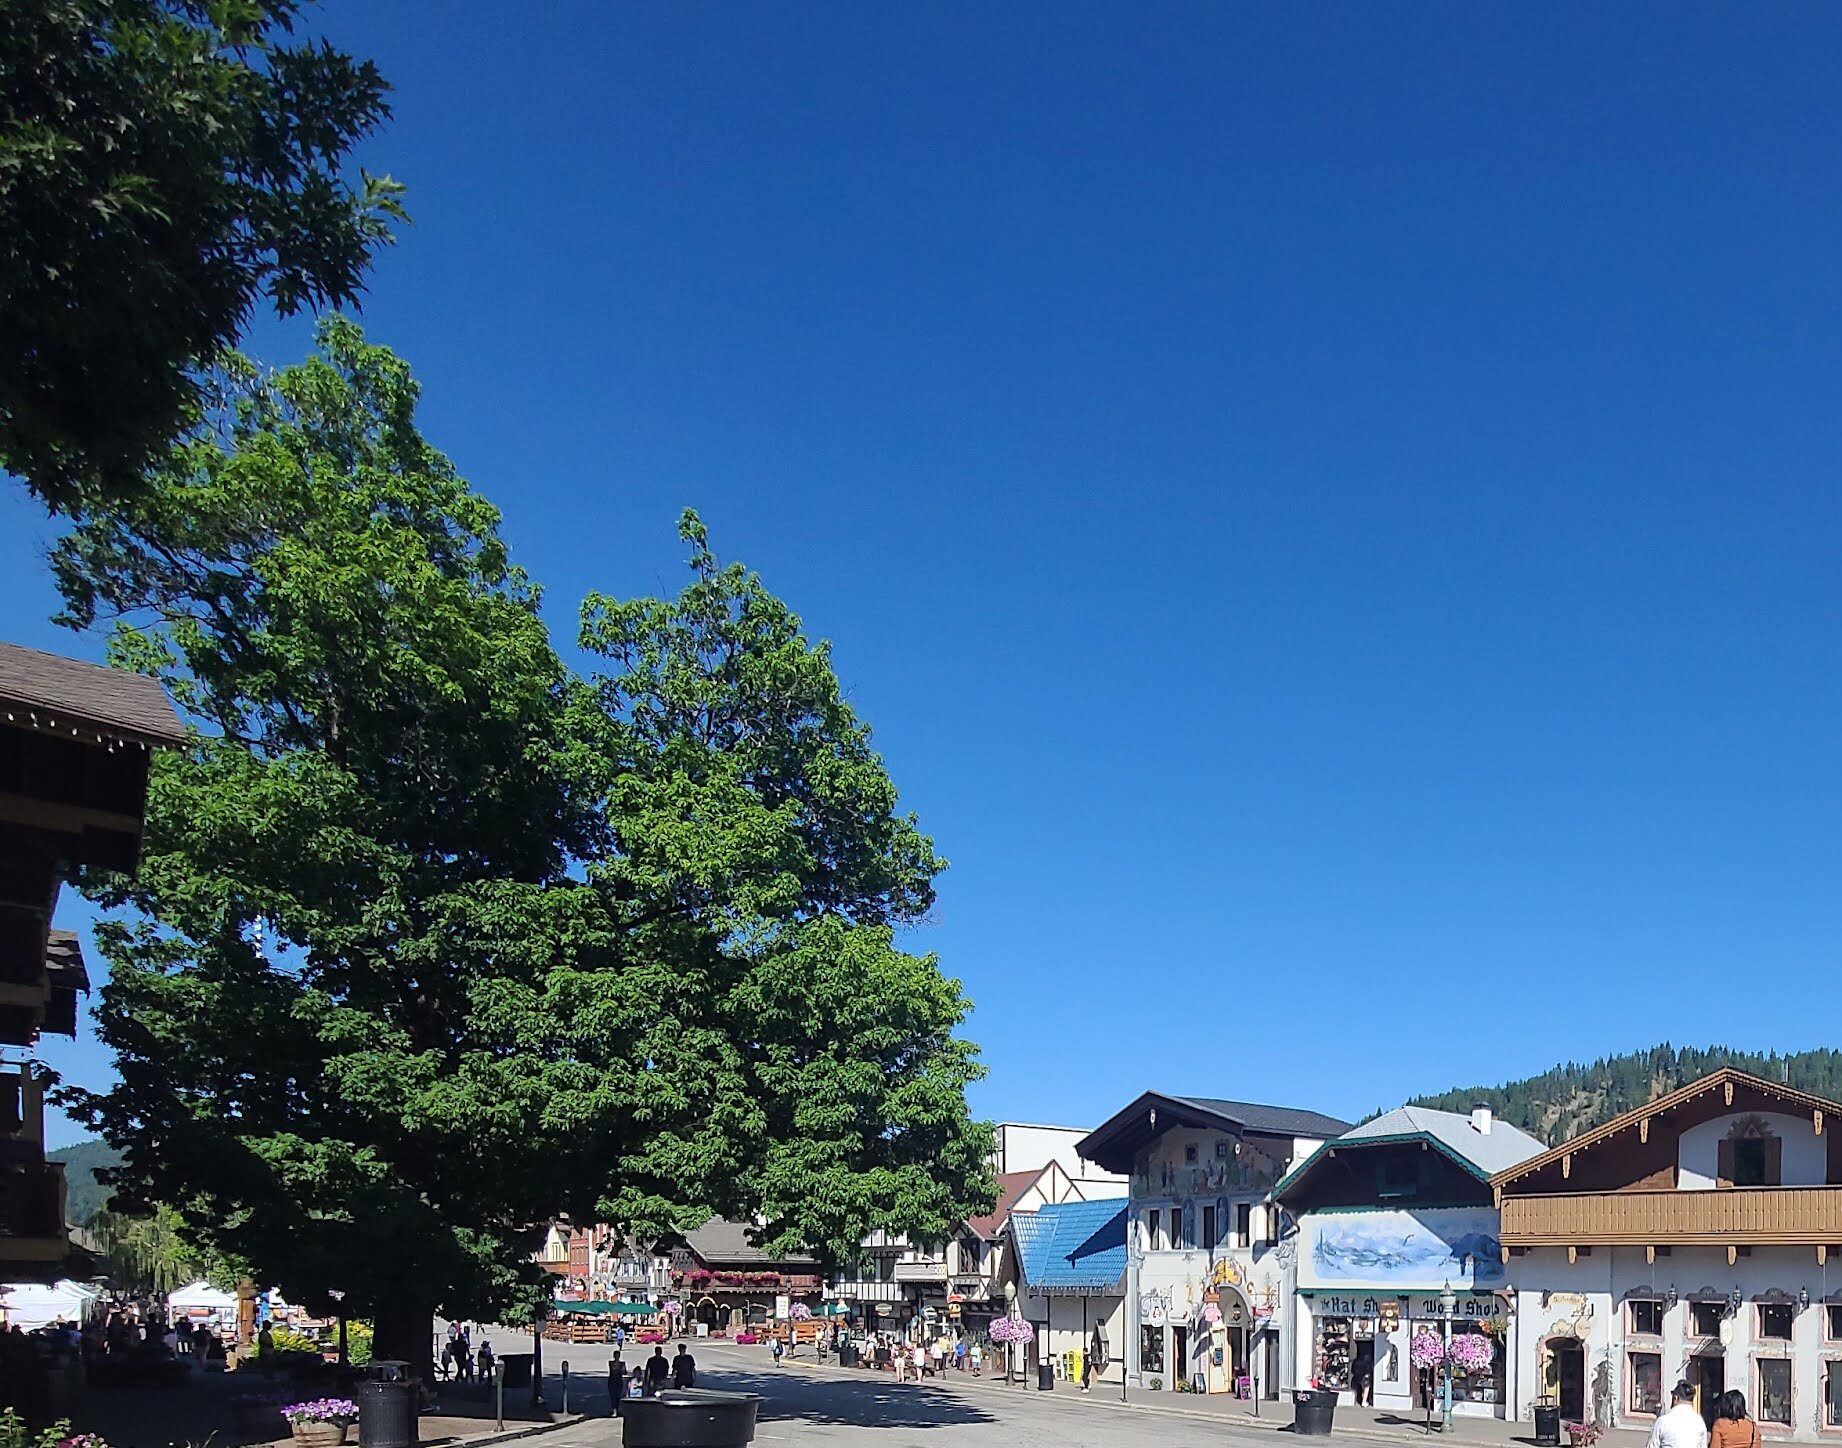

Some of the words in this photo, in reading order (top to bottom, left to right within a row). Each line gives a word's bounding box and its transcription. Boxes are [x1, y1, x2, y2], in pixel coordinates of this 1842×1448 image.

[1331, 1296, 1355, 1313] Hat
[1363, 1295, 1379, 1313] Sh
[1422, 1299, 1460, 1315] Wod
[1465, 1298, 1500, 1318] Shop
